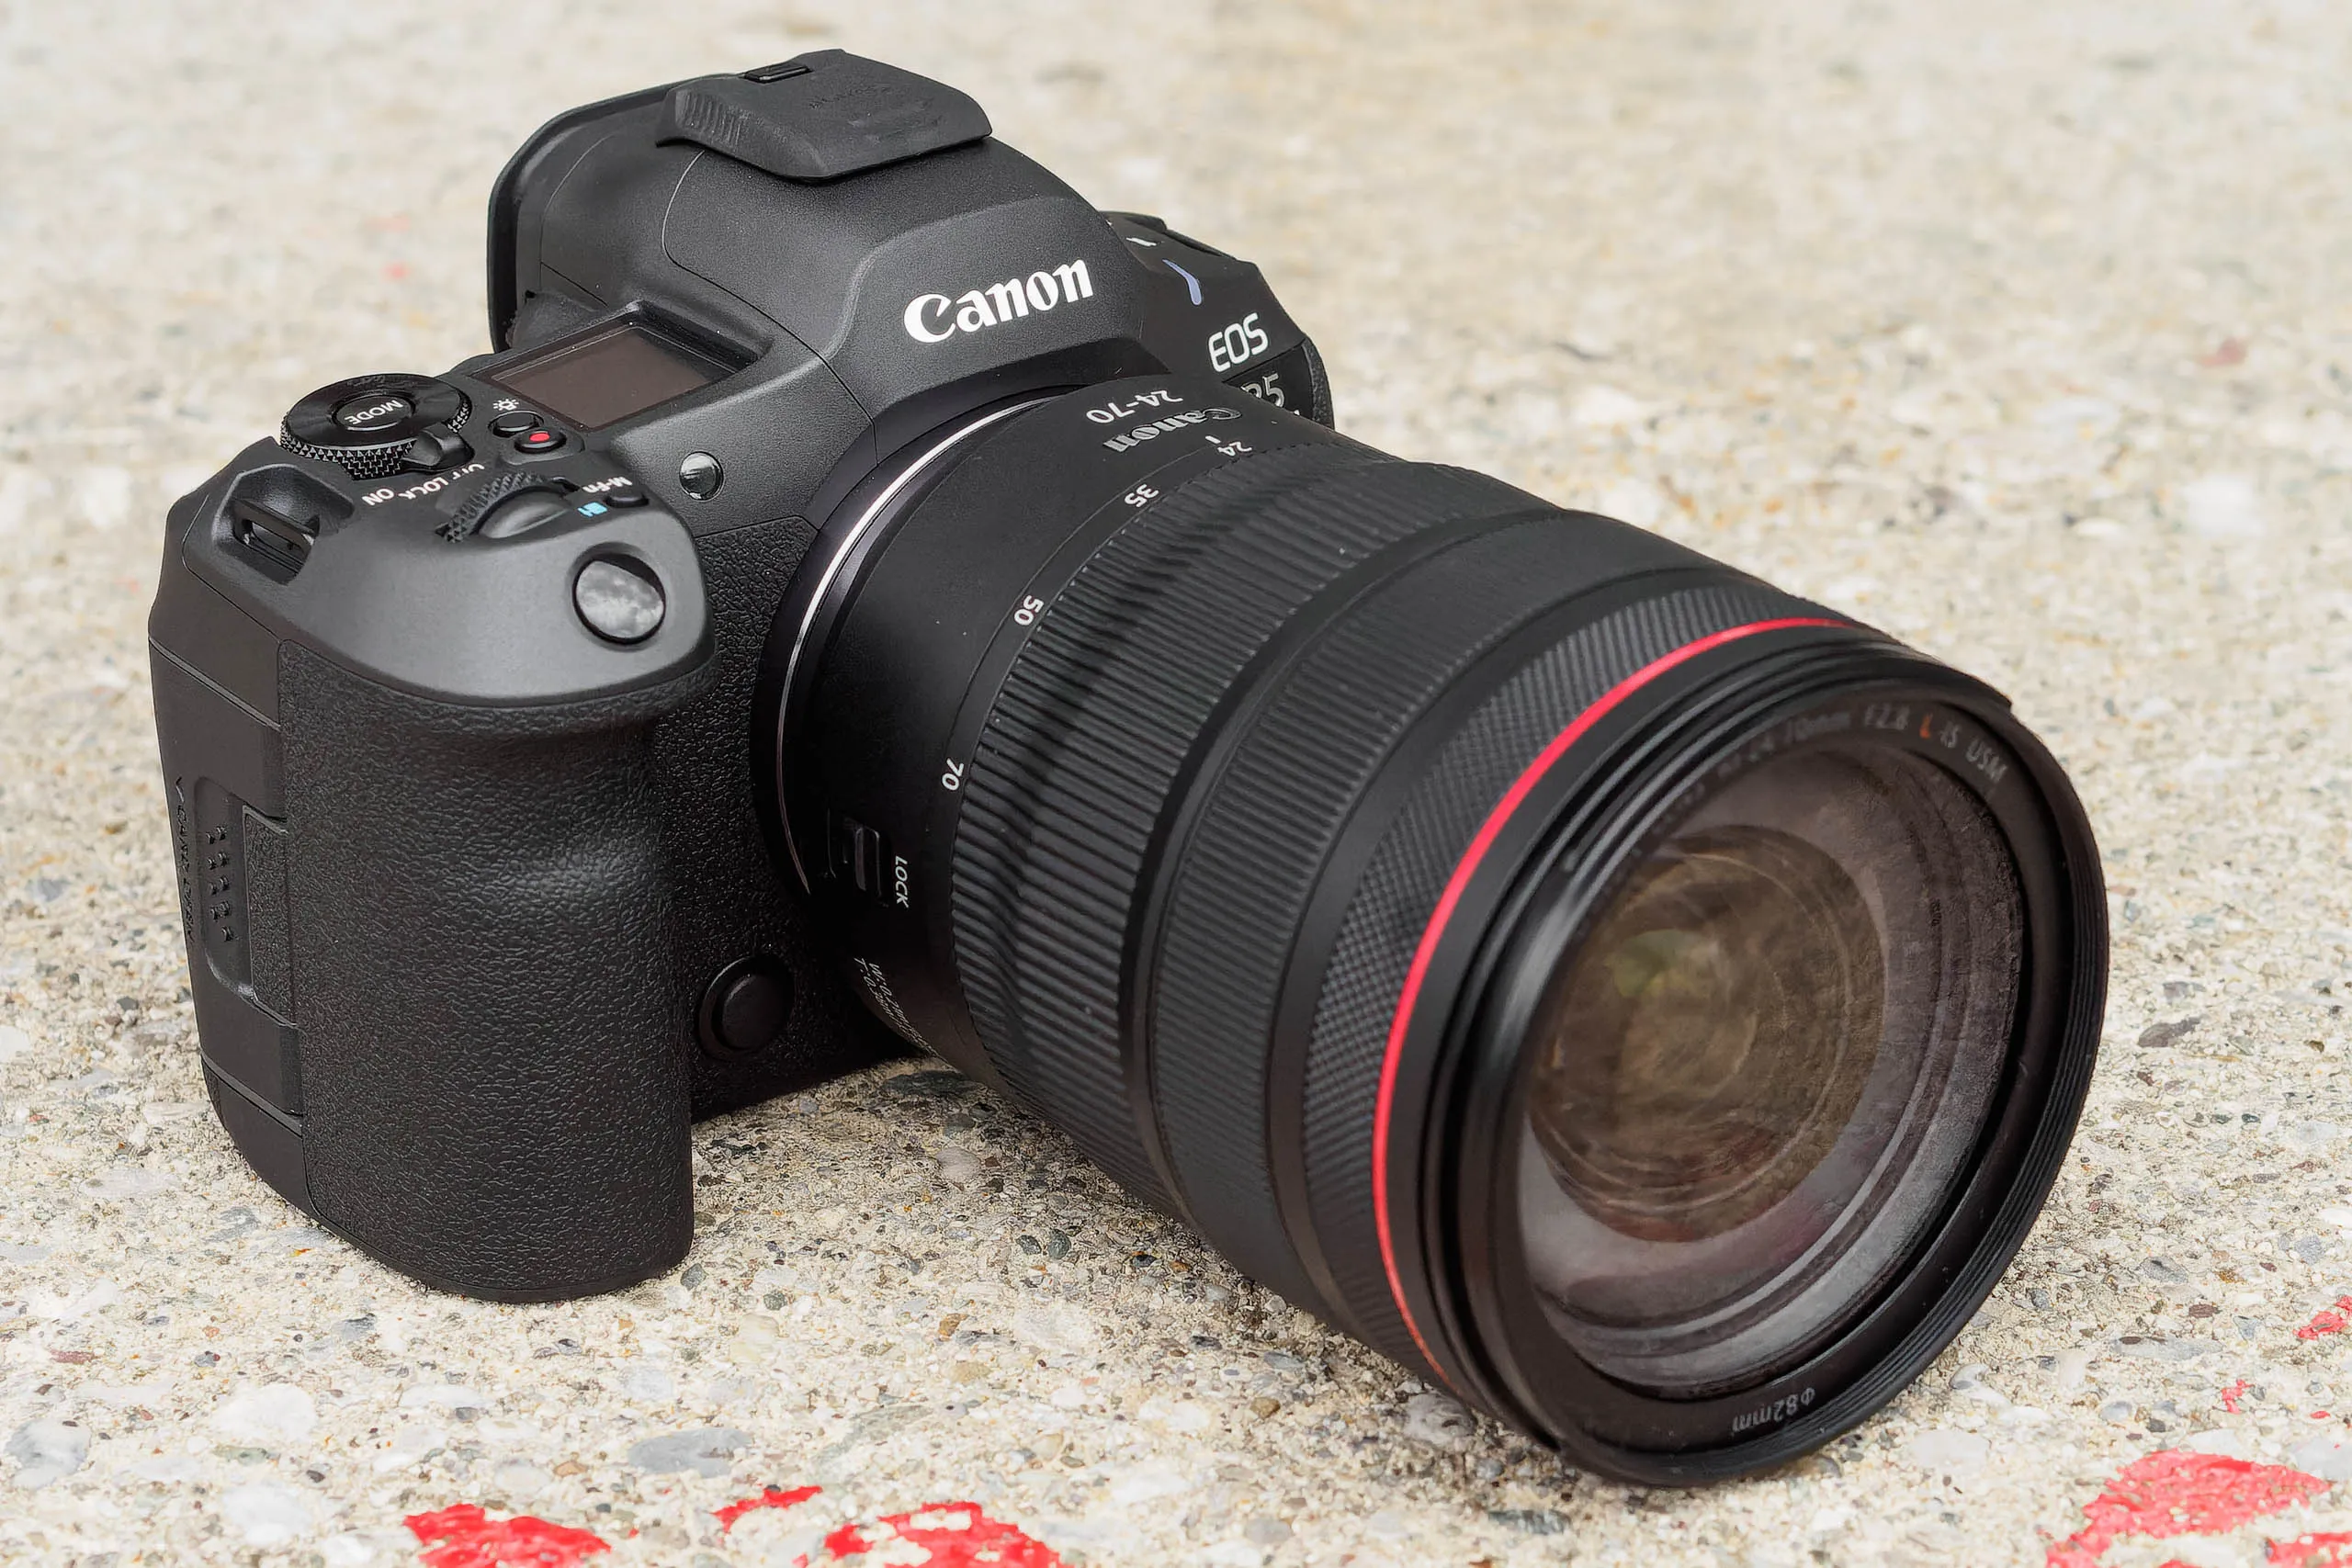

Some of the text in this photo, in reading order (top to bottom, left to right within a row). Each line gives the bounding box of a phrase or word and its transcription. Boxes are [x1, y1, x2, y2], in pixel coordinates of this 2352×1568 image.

[903, 258, 1094, 344] Canon
[1207, 311, 1270, 373] EOS
[344, 400, 403, 425] MODE
[1086, 389, 1183, 423] 24-70
[1102, 407, 1242, 453] Canon
[1216, 441, 1253, 457] 24
[361, 488, 395, 506] ON
[398, 476, 449, 500] LOCK
[1124, 483, 1159, 508] 35
[1013, 594, 1045, 626] 50
[941, 757, 965, 791] 70
[895, 855, 910, 908] LOCK
